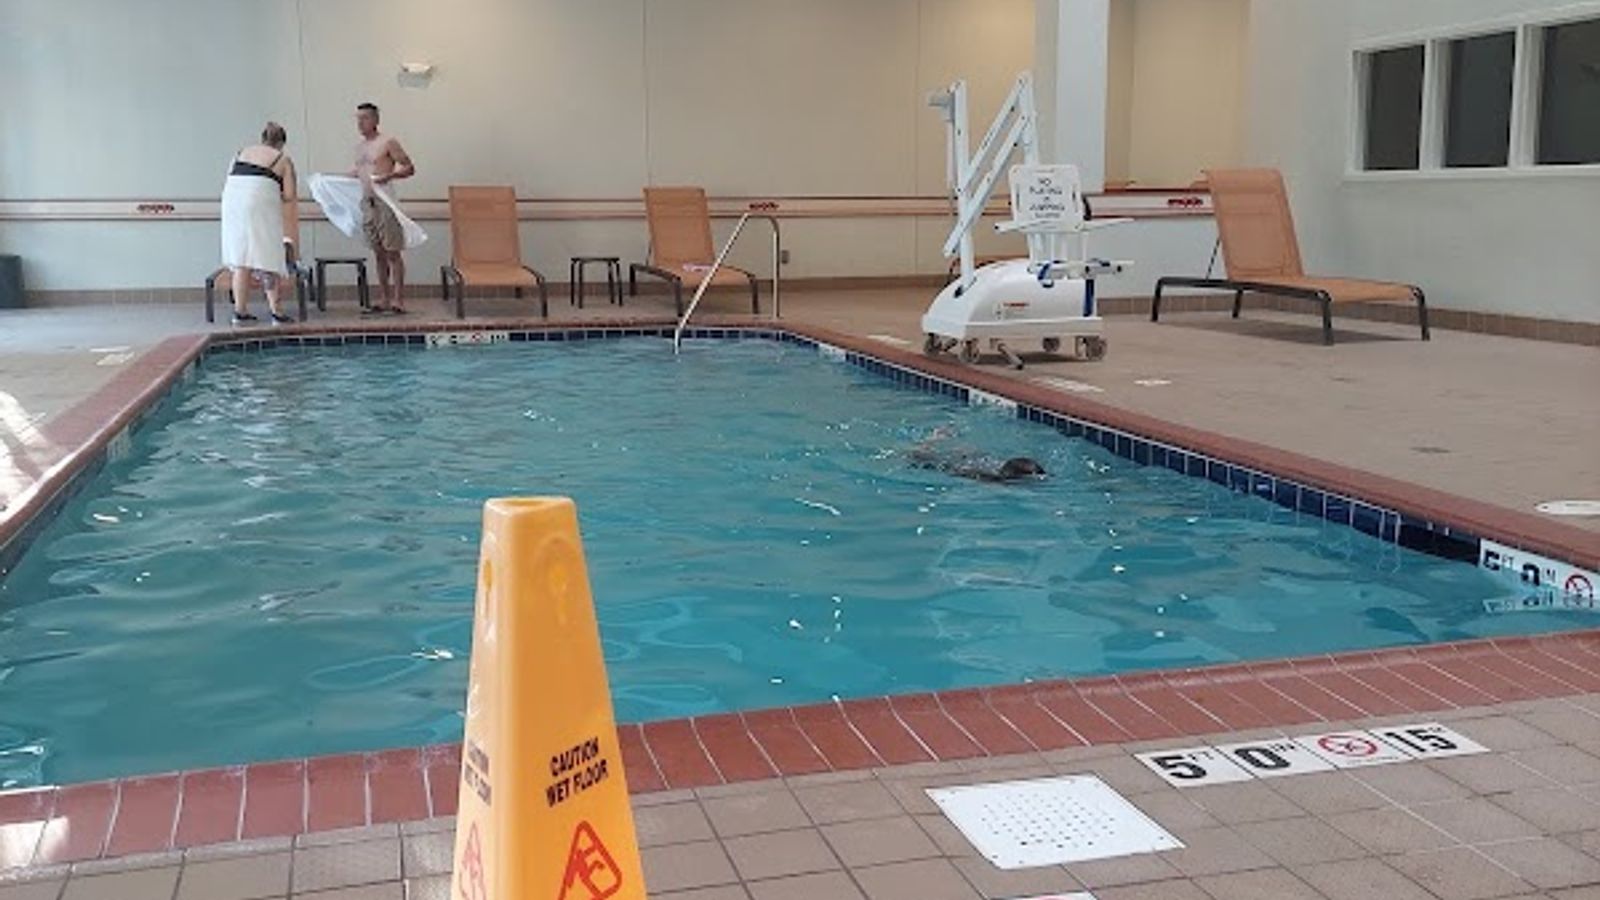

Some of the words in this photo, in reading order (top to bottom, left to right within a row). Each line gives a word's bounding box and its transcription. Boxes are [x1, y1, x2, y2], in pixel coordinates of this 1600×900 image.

[549, 736, 599, 777] CAUTION
[545, 778, 569, 809] WET
[573, 758, 609, 795] FLOOR
